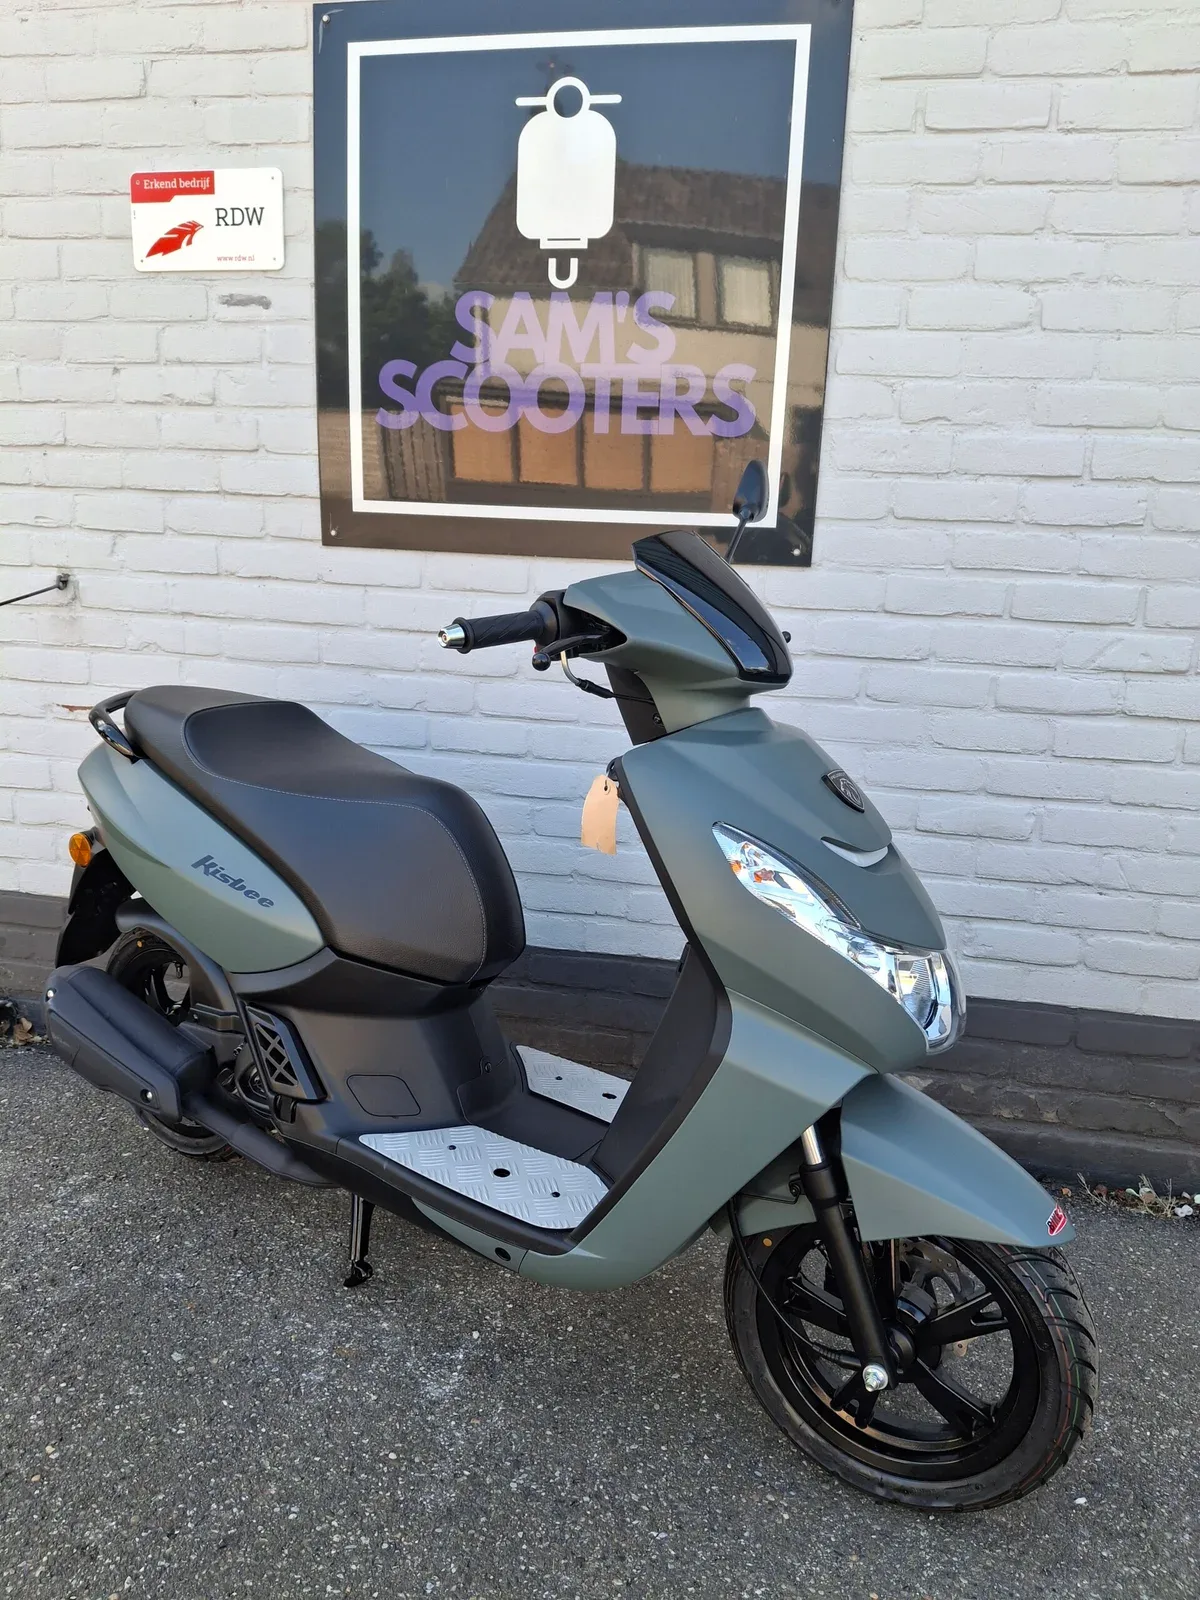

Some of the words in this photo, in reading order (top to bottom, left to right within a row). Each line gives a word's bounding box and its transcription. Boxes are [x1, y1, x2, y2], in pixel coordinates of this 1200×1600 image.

[143, 178, 177, 190] Erkend
[179, 177, 210, 190] bedrijf
[215, 207, 265, 227] RDW
[216, 254, 255, 262] www.rdw.nl
[450, 290, 676, 365] SAM'S
[375, 359, 758, 438] SCOOTERS
